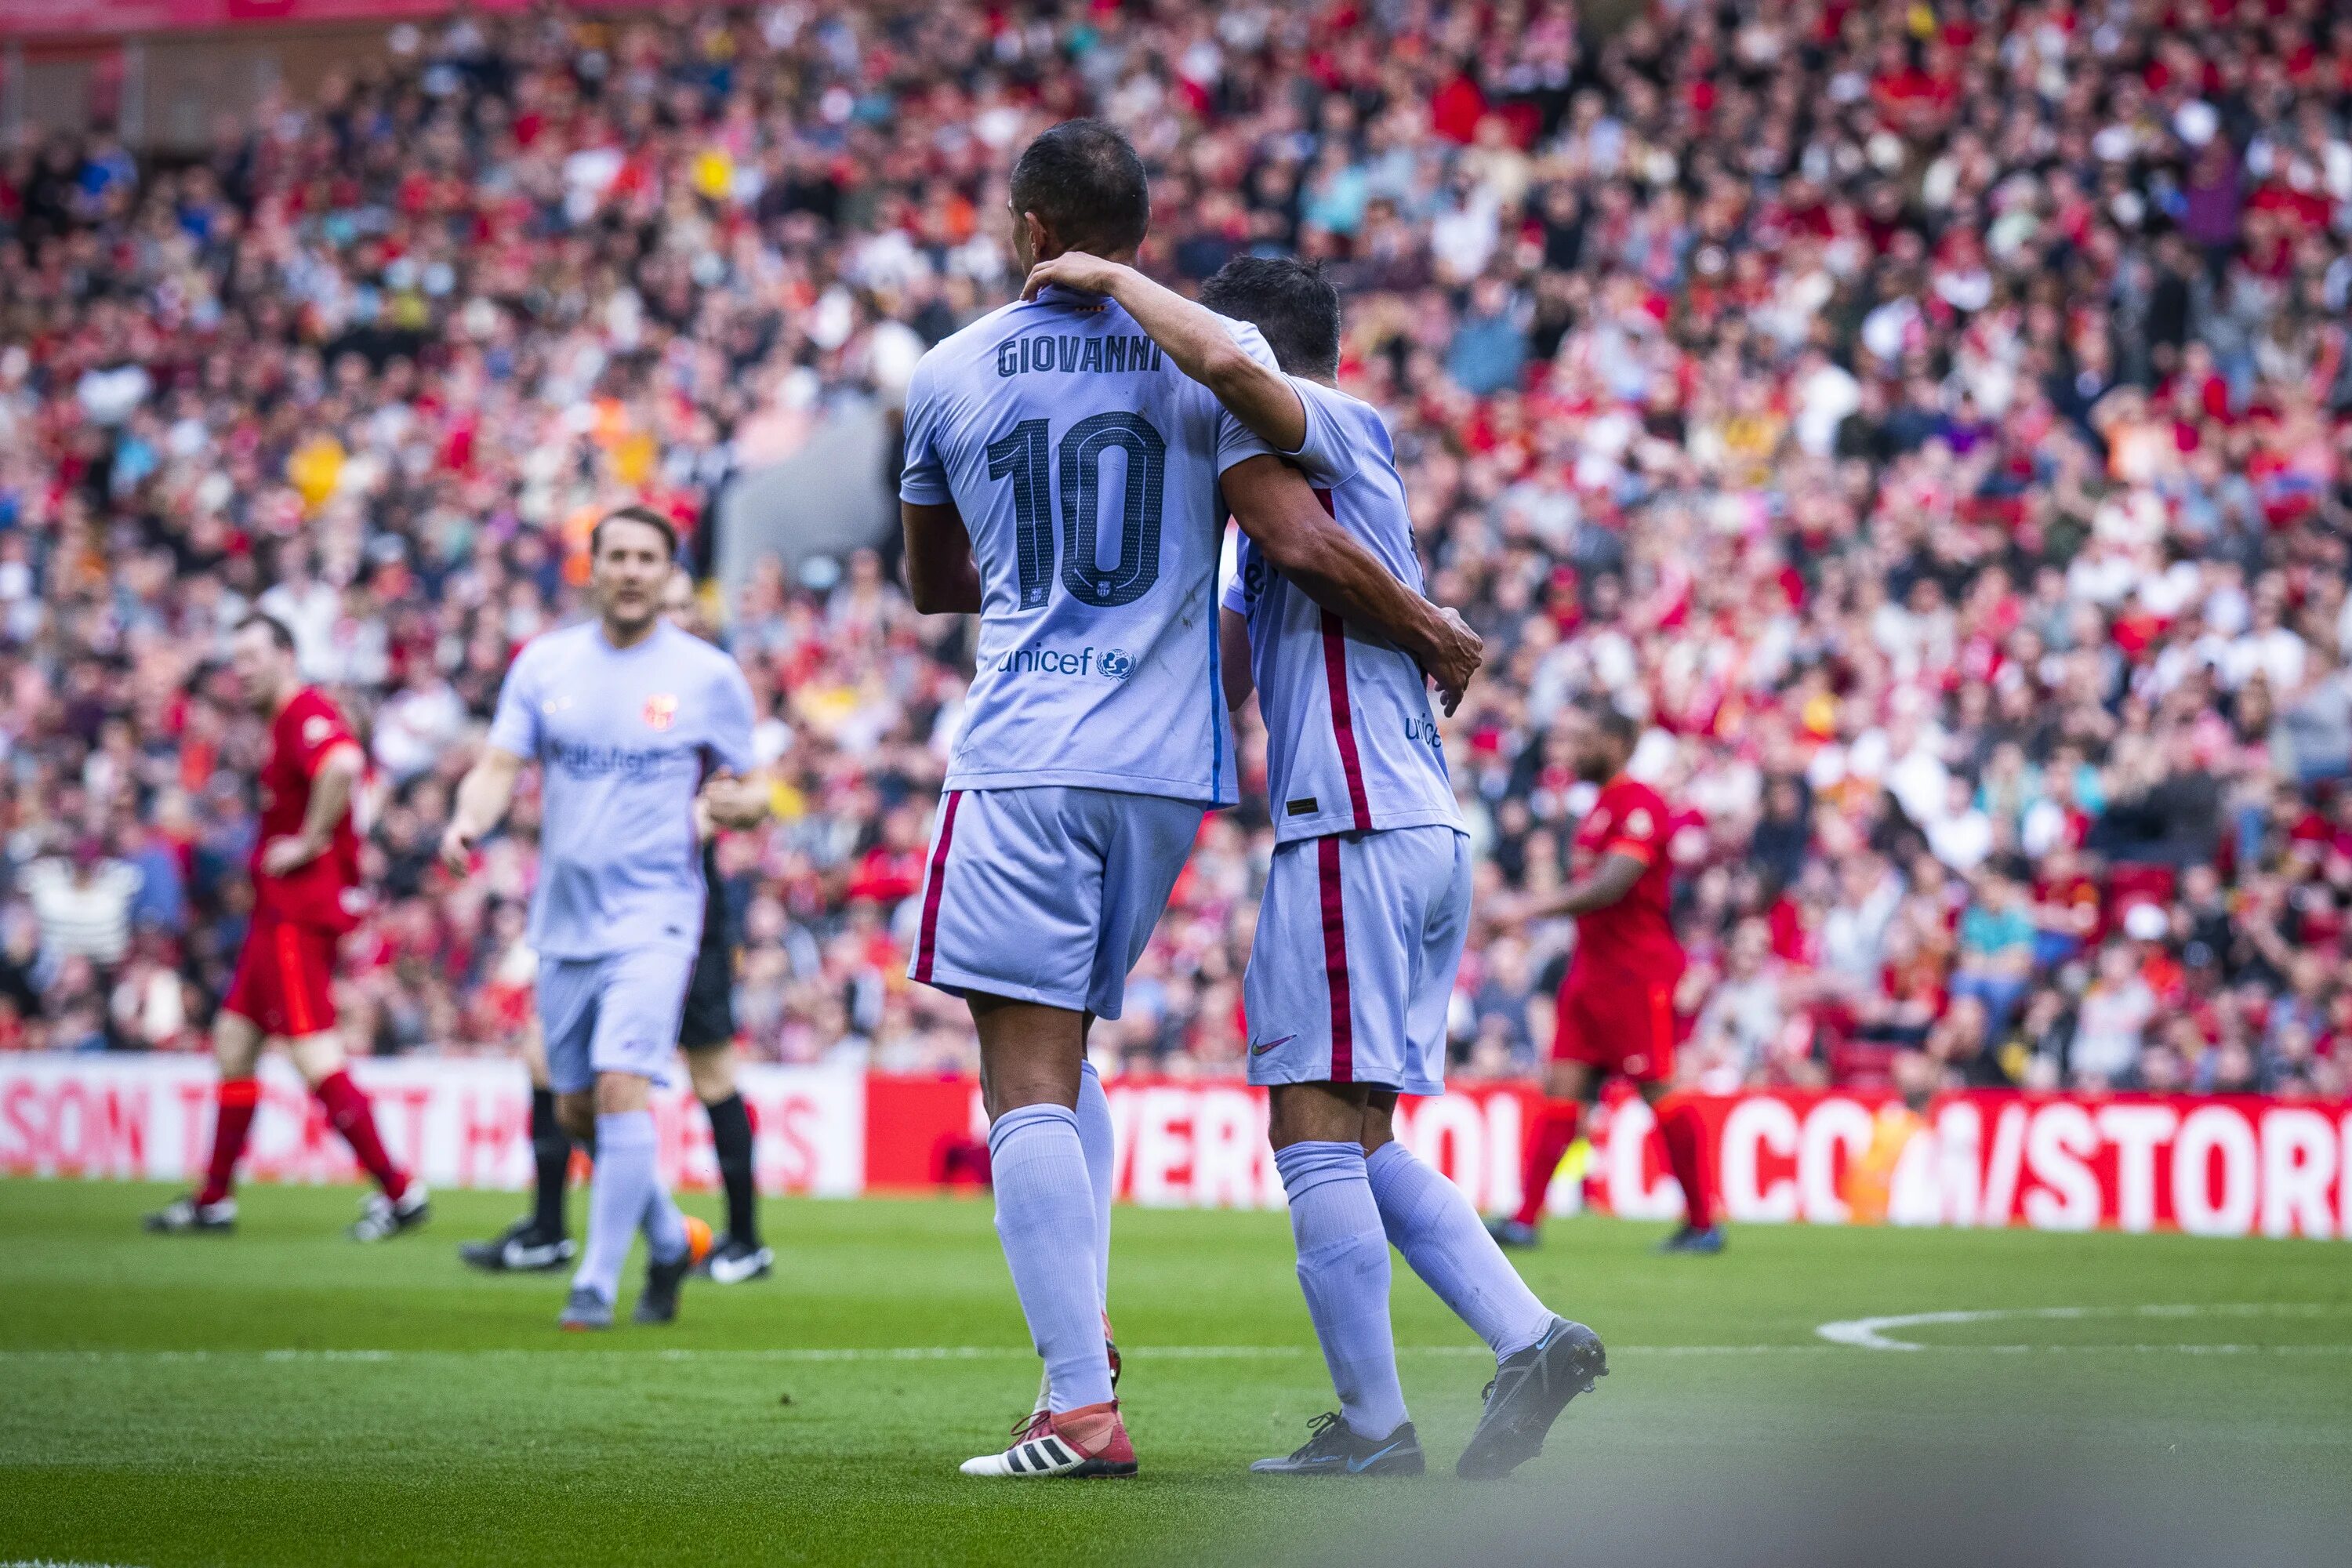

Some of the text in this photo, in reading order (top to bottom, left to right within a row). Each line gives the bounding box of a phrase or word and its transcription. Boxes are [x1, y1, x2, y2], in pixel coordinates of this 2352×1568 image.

[997, 335, 1162, 378] GIOVANNI
[986, 411, 1167, 612] 10
[997, 641, 1094, 676] unicef
